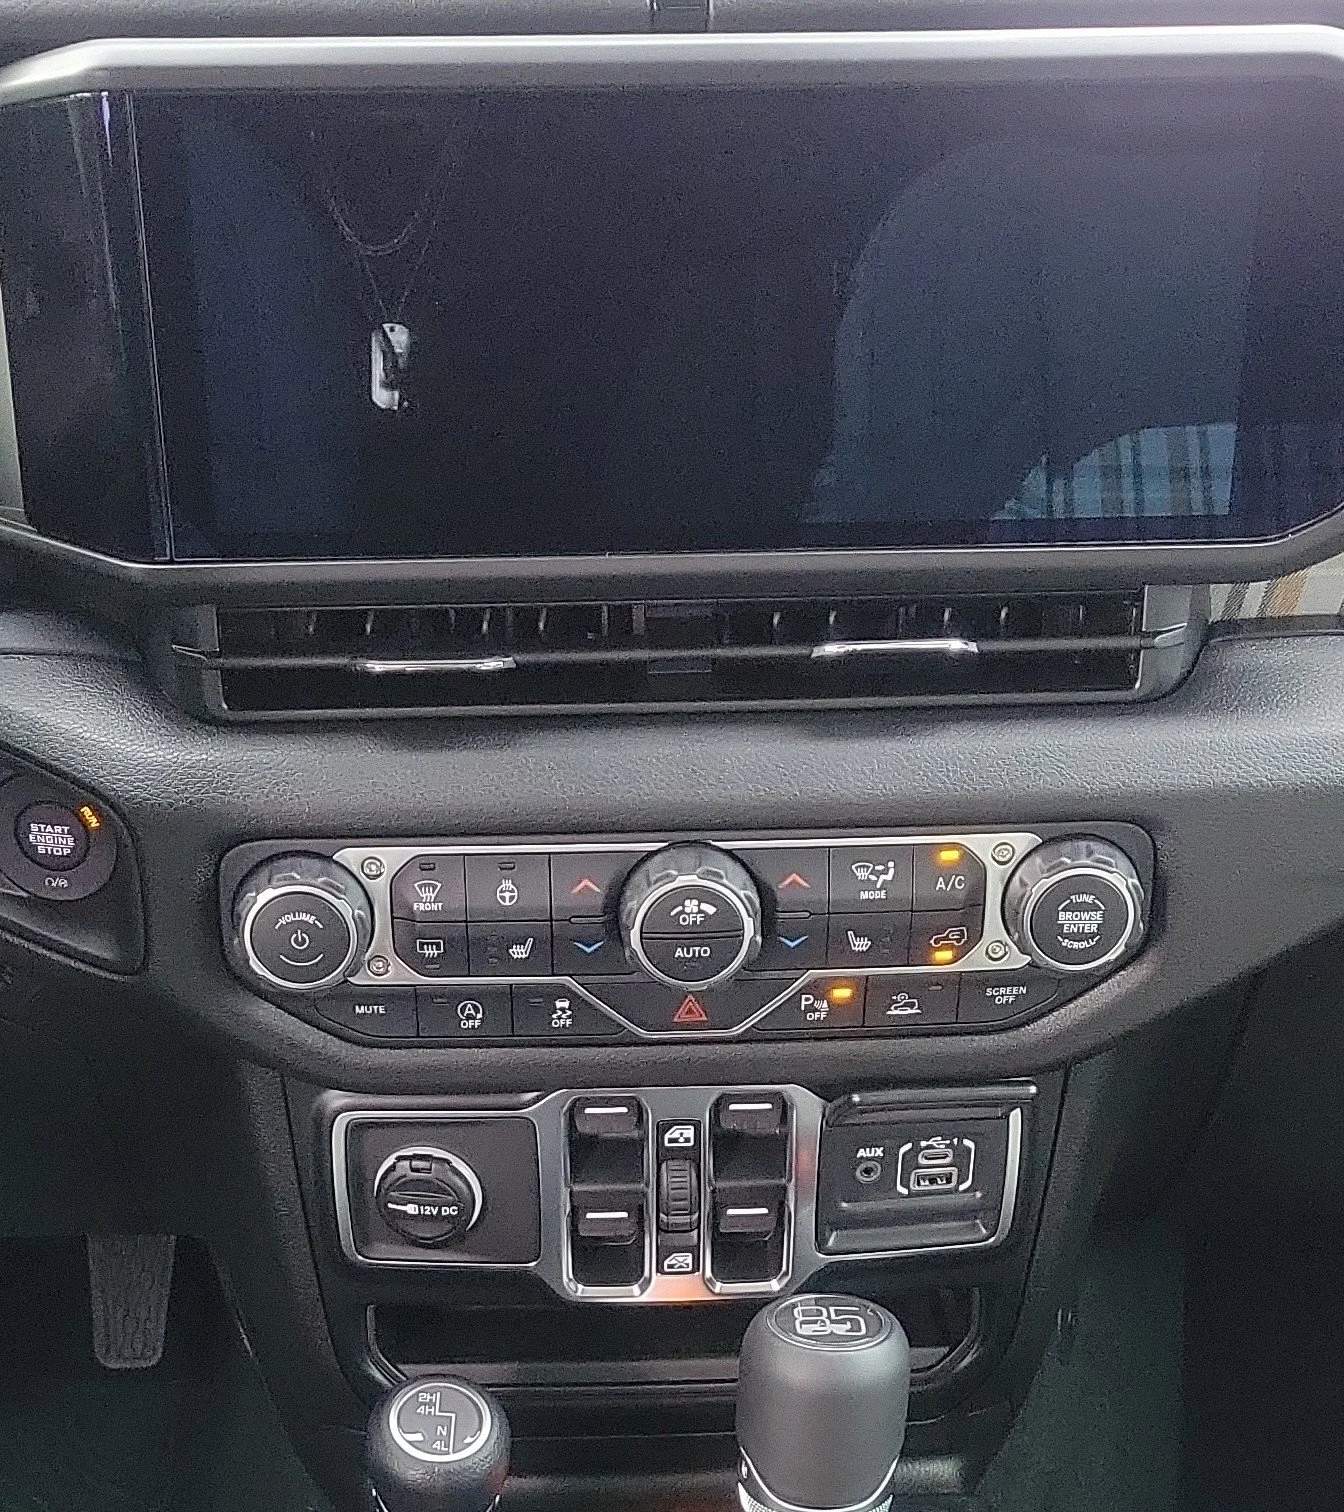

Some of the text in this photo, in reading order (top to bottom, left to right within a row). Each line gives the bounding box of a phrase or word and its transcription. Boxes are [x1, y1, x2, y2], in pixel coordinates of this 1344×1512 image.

[79, 806, 100, 829] RUN
[29, 823, 71, 834] START
[28, 833, 75, 846] ENGINE
[37, 845, 72, 856] STOP
[935, 875, 965, 891] A/C
[859, 890, 887, 900] MODE
[1069, 893, 1096, 904] TUNE
[413, 902, 443, 912] FRONT
[278, 911, 317, 925] VOLUME
[679, 914, 705, 926] OFF
[1058, 910, 1104, 921] BROWSE
[1063, 923, 1099, 933] ENTER
[1061, 938, 1097, 950] SCROLL
[674, 947, 711, 958] AUTO
[985, 986, 1027, 997] SCREEN
[800, 995, 815, 1010] P
[994, 994, 1016, 1005] OFF
[355, 1004, 386, 1015] MUTE
[806, 1012, 828, 1021] OFF
[460, 1018, 482, 1030] OFF
[551, 1018, 573, 1029] OFF
[856, 1146, 884, 1158] AUX
[420, 1205, 459, 1216] 12V DC
[418, 1392, 436, 1402] 2H
[416, 1405, 435, 1416] 4H
[436, 1425, 447, 1436] N
[432, 1440, 449, 1452] 4L
